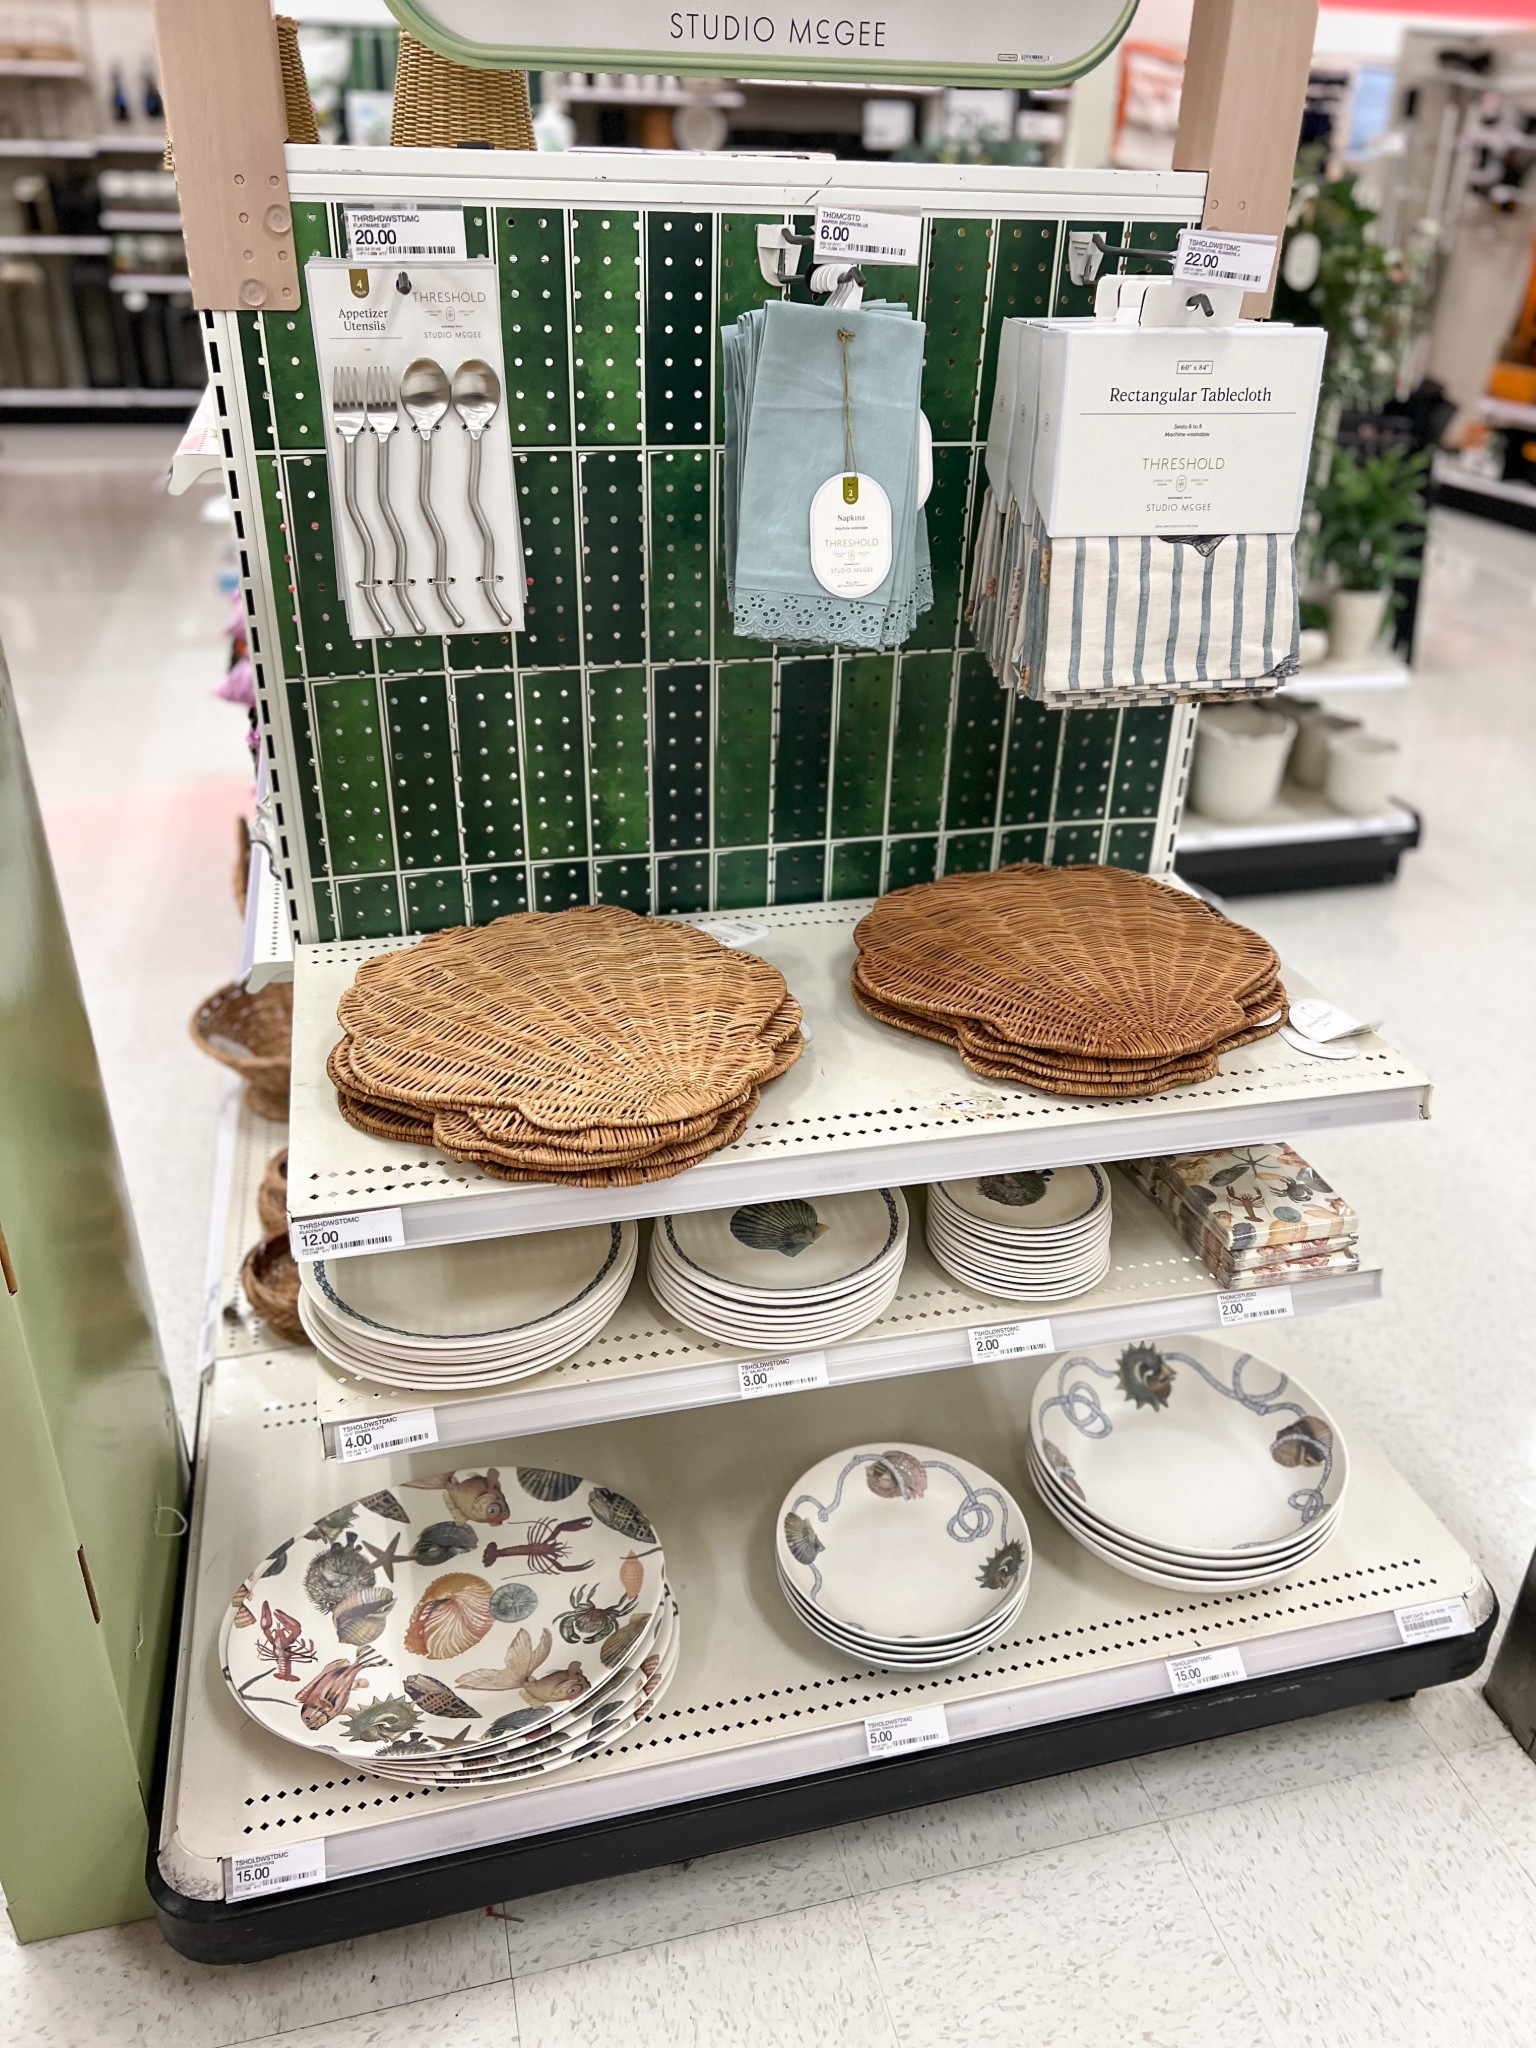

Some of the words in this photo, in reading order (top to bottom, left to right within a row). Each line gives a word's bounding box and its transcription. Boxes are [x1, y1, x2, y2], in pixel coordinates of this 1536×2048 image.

[670, 13, 776, 42] STUDIO
[352, 215, 420, 223] THRSHDWSTDMC
[822, 211, 860, 222] THDMCSTD
[355, 230, 397, 244] 20.00
[821, 225, 849, 241] 6.00
[1189, 239, 1240, 252] TSHOLDWSTDMC
[1185, 252, 1218, 268] 22.00
[357, 279, 363, 289] 4
[412, 292, 486, 303] THRESHOLD
[338, 308, 388, 320] Appetizer
[344, 321, 386, 331] Utensils
[1110, 387, 1197, 405] Rectangular
[1201, 387, 1271, 402] Tablecloth
[1142, 458, 1226, 470] THRESHOLD
[825, 539, 878, 548] THRESHOLD
[298, 1217, 359, 1231] THRSHDWSTDMC
[301, 1231, 338, 1247] 12.00
[1222, 1303, 1243, 1315] 2.00
[976, 1339, 999, 1351] 2.00
[741, 1359, 790, 1371] TSHOLDWSTDMC
[743, 1373, 767, 1386] 3.00
[342, 1417, 397, 1433] TSHOLDWSTDMC
[345, 1433, 372, 1448] 4.00
[1175, 1668, 1201, 1682] 15.00
[870, 1730, 892, 1744] 5.00
[235, 1852, 288, 1867] TSHOLDWSTDMC
[237, 1867, 269, 1883] 15.00
